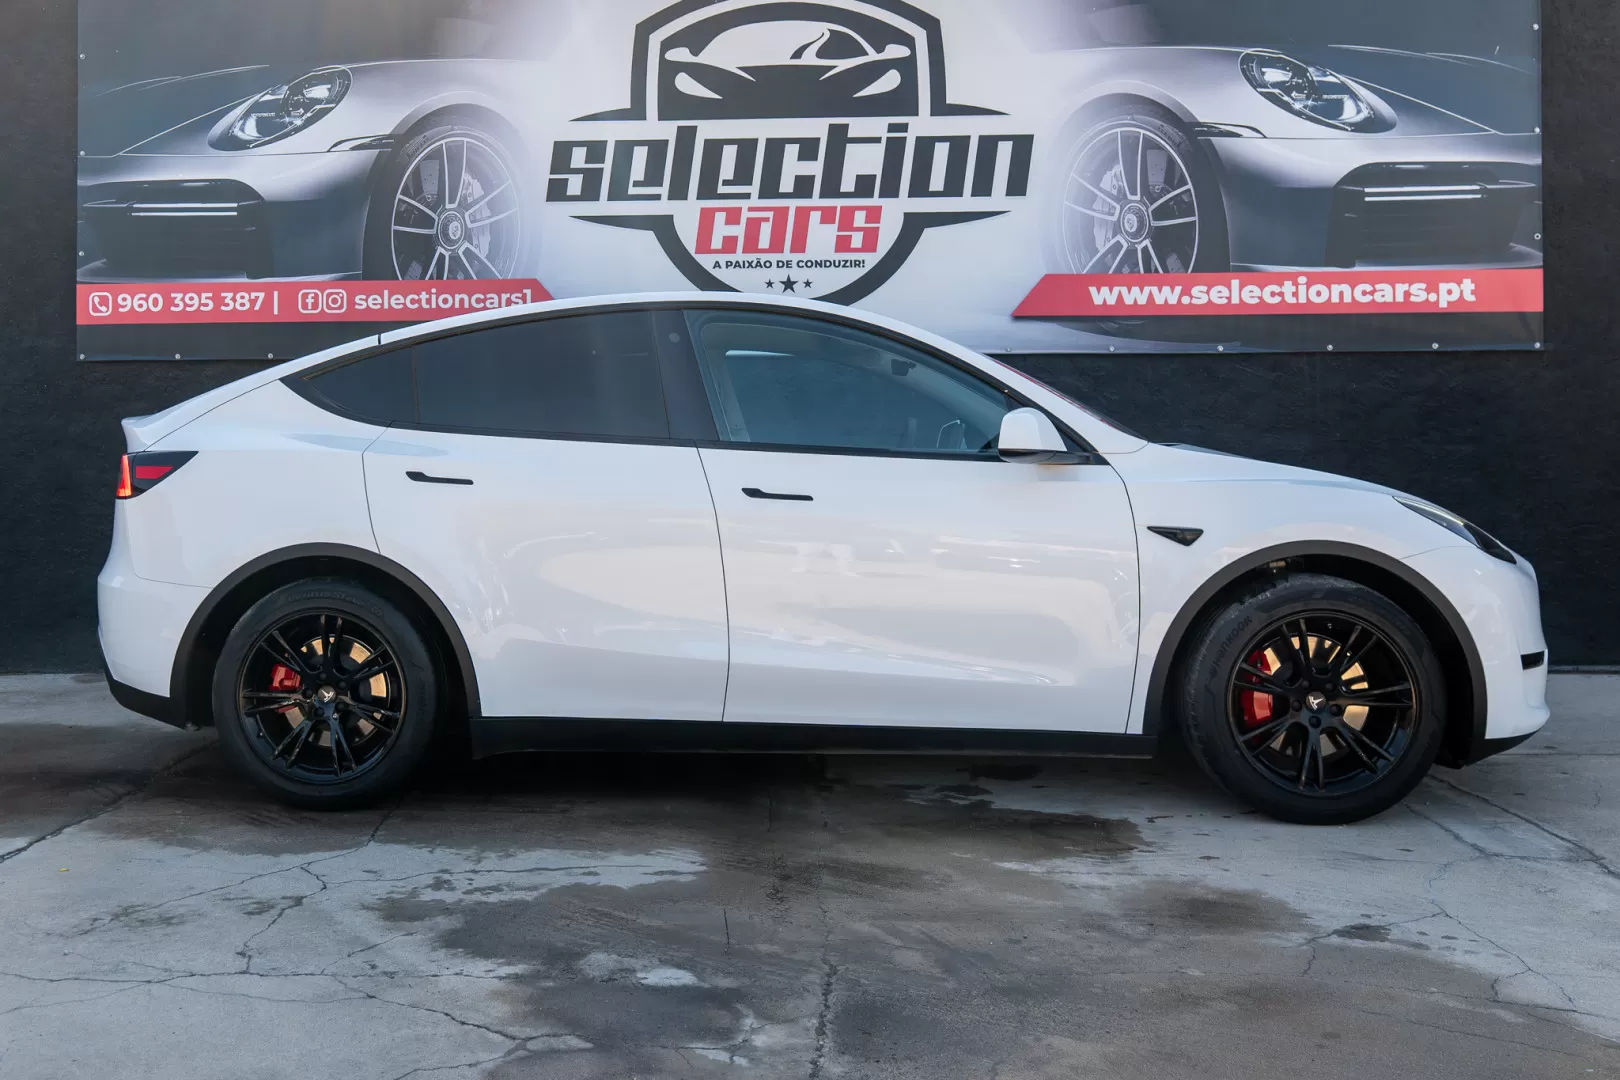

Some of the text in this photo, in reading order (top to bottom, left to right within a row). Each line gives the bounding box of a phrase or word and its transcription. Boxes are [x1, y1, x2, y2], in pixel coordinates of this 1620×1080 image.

[546, 122, 1035, 202] selection
[695, 205, 883, 255] cars
[712, 257, 866, 270] A PAIXÃO DE CONDUZIR!
[116, 291, 266, 313] 960 395 387
[353, 288, 532, 311] selectioncars1
[1088, 275, 1477, 308] www.selectioncars.pt
